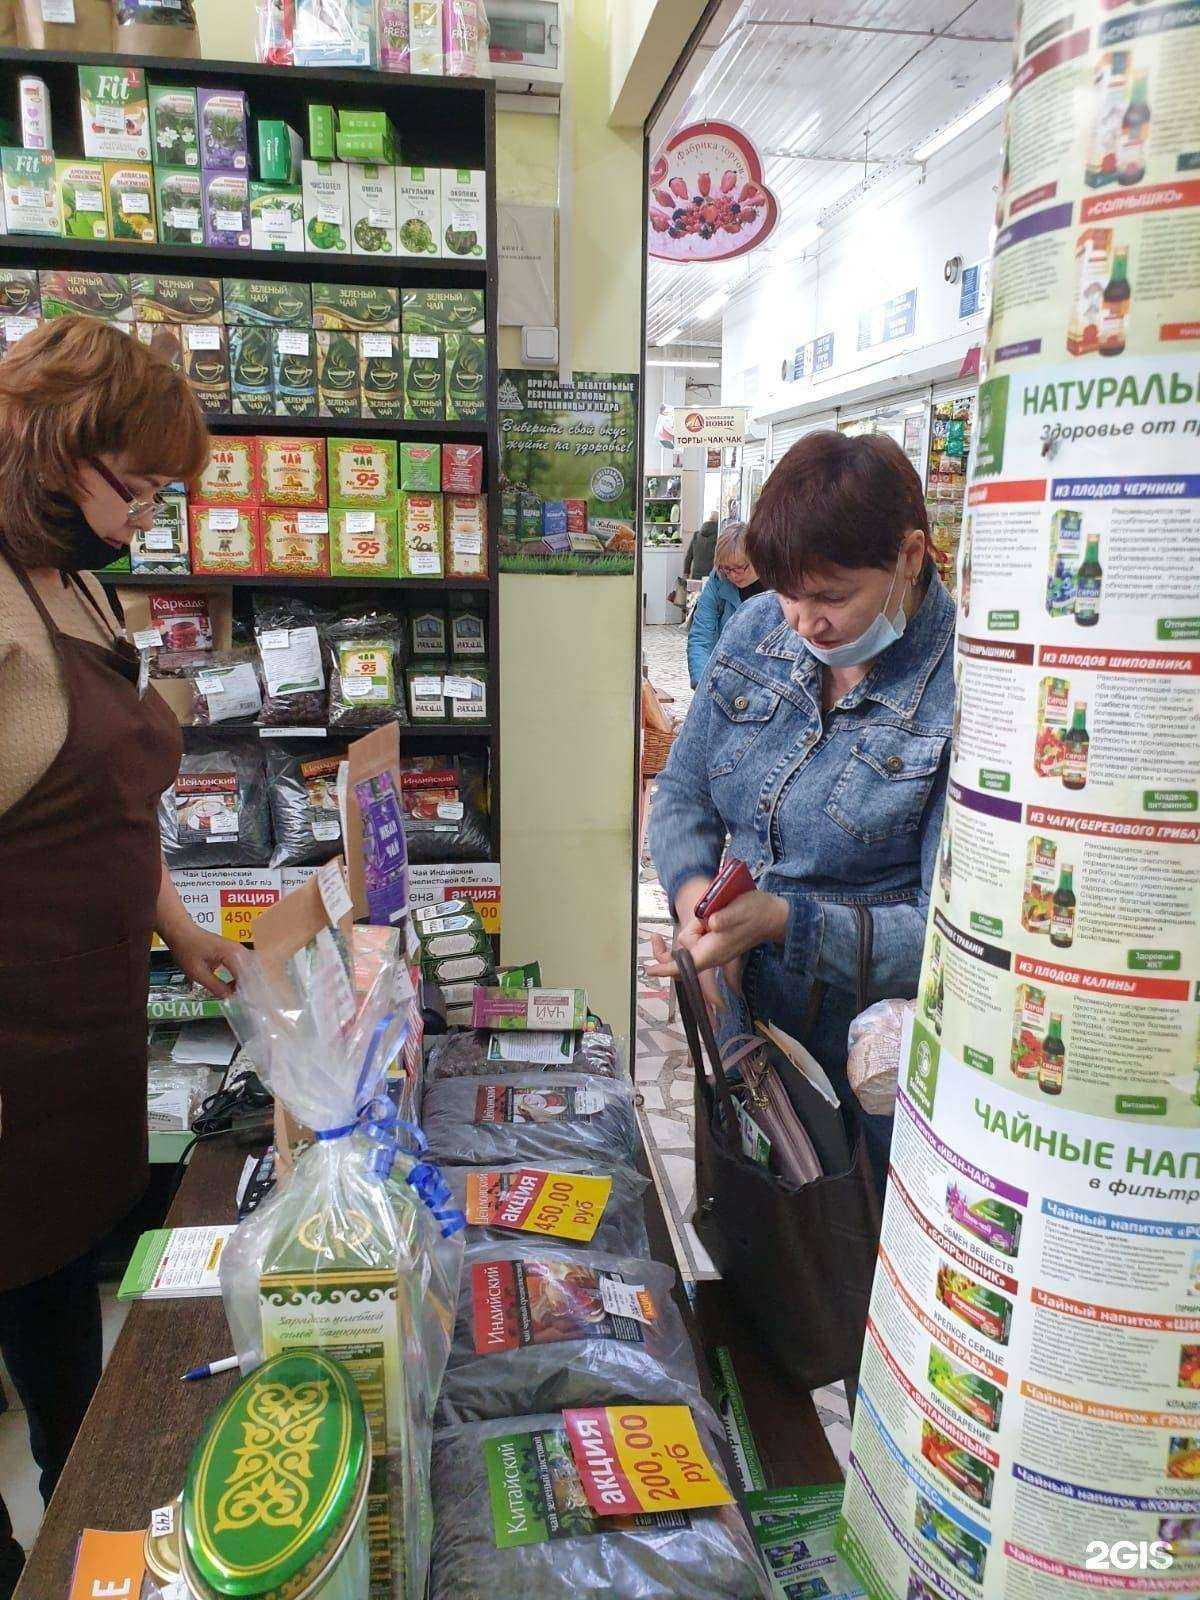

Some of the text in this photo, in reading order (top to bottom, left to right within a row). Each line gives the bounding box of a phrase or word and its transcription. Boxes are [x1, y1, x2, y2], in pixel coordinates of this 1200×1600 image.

[97, 75, 130, 100] Fit
[677, 142, 718, 160] Фабрика
[16, 154, 41, 174] Fit
[67, 277, 103, 286] ЧЕРНЫЙ
[158, 279, 194, 289] ЧЕРНЫЙ
[67, 286, 87, 295] ЧАЙ
[159, 289, 177, 298] ЧАЙ
[250, 284, 287, 294] ЗЕЛЕНЫЙ
[339, 290, 376, 299] ЗЕЛЕНЫЙ
[250, 294, 268, 302] ЧАЙ
[339, 298, 357, 307] ЧАЙ
[426, 293, 462, 302] ЗЕЛЕНЫЙ
[426, 301, 444, 310] ЧАЙ
[577, 380, 634, 392] ЖЕВАТЕЛЬНЫЕ
[563, 390, 574, 399] ИЗ
[576, 391, 607, 401] СМОЛЫ
[1022, 372, 1200, 416] НАТУРАЛЬ
[502, 418, 627, 440] Выберите свой вкус
[1040, 420, 1175, 442] Здоровье от
[555, 441, 569, 451] на
[212, 453, 234, 463] ЧАЙ
[281, 453, 302, 464] ЧАЙ
[353, 456, 373, 466] ЧАЙ
[356, 473, 380, 486] 95
[1055, 482, 1185, 497] ИЗ ПЛОДОВ ЧЕРНИКИ
[283, 524, 298, 534] ЧА
[416, 523, 430, 532] 95
[357, 541, 380, 555] 95
[153, 598, 205, 610] Каркаде
[362, 664, 376, 673] 95
[1043, 653, 1193, 670] ИЗ ПЛОДОВ ШИПОВНИКА
[177, 776, 236, 788] Цейлонский
[403, 774, 455, 784] Индийский
[1030, 812, 1043, 822] ИЗ
[201, 870, 252, 879] Цейлонский
[430, 868, 473, 876] Индийский
[181, 894, 209, 904] ена
[227, 893, 275, 905] акция
[451, 890, 497, 901] акция
[1019, 961, 1137, 992] ИЗ ПЛОДОВ КАЛИНЫ
[536, 1006, 565, 1020] ЧАЙ
[974, 1098, 1115, 1170] ЧАЙНЫЕ
[937, 1143, 995, 1192] «ИВАН-ЧАЙ»
[1089, 1178, 1101, 1189] в
[476, 1173, 489, 1223] Цейлонский
[501, 1175, 538, 1222] акция
[534, 1182, 574, 1231] 450,00
[572, 1200, 594, 1225] руб
[1047, 1202, 1106, 1227] Чайный
[1110, 1220, 1173, 1237] напиток
[942, 1223, 1015, 1274] ОБМЕН ВЕЩЕСТВ
[928, 1227, 1006, 1288] «БОЯРЫШНИК»
[482, 1266, 506, 1344] Индийский
[1037, 1292, 1097, 1318] Чайный
[1101, 1310, 1162, 1329] напиток
[934, 1310, 1005, 1366] КРЕПКОЕ СЕРДЦЕ
[952, 1342, 994, 1378] ТРАВА»
[1026, 1383, 1149, 1424] Чайный напиток
[930, 1391, 992, 1443] ПИЩЕВАРЕНИЕ
[911, 1390, 994, 1463] «ВИТАМИННЫЙ»
[577, 1418, 627, 1506] акция
[619, 1414, 677, 1502] 200,00
[664, 1443, 711, 1484] руб
[499, 1443, 527, 1533] Китайский
[1017, 1467, 1139, 1511] Чайный напиток
[1009, 1544, 1064, 1576] Чайный
[1068, 1568, 1127, 1588] напиток
